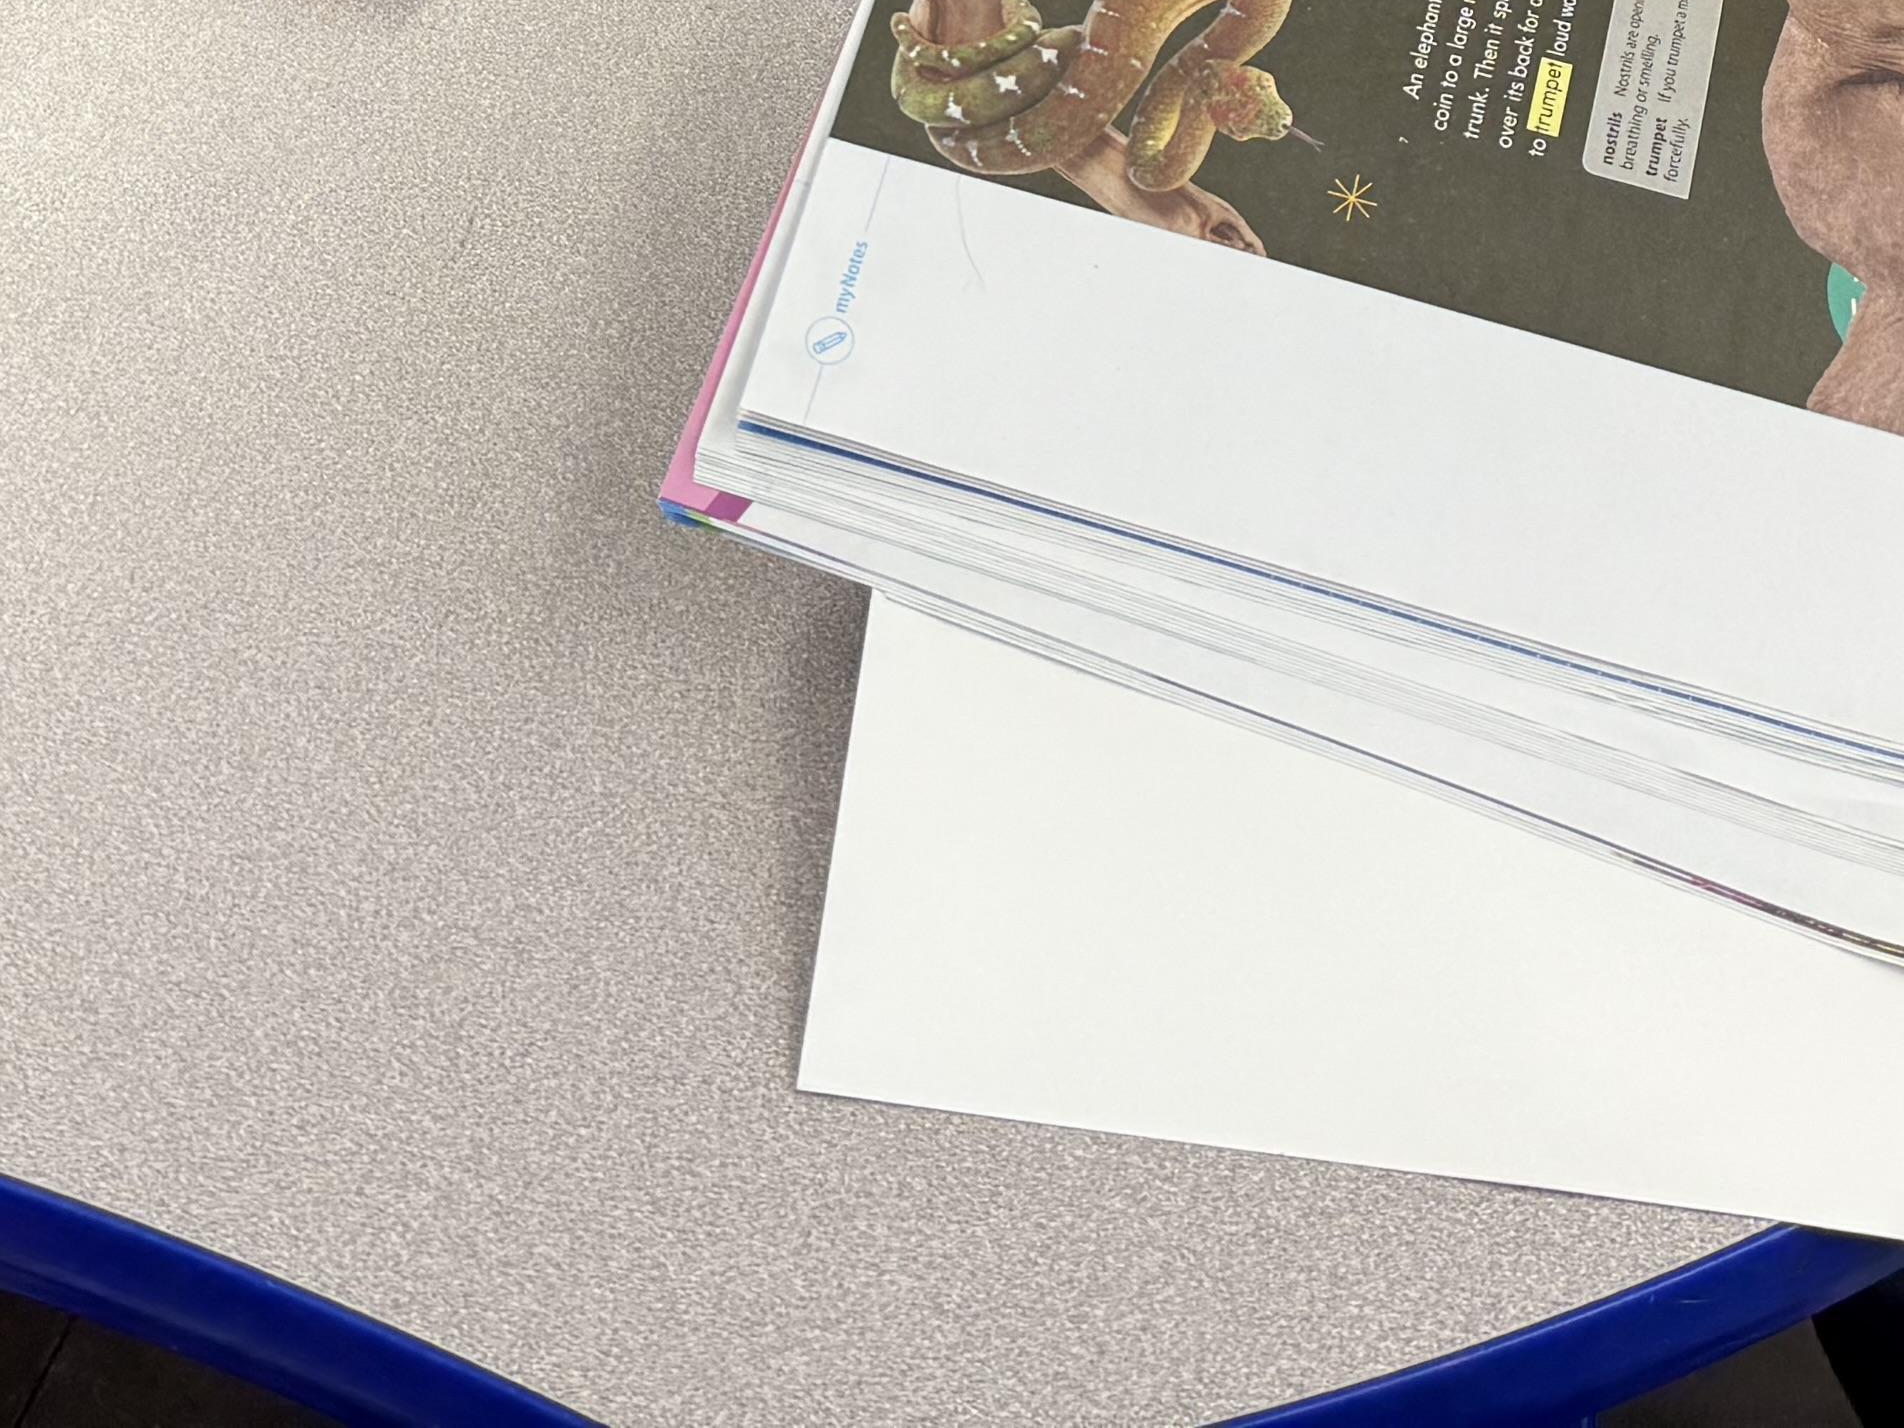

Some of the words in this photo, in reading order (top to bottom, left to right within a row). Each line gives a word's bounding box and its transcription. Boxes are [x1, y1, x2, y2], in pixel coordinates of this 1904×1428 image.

[1446, 6, 1476, 49] large
[1483, 22, 1504, 35] it
[1517, 9, 1539, 33] for
[1675, 10, 1688, 19] a
[1546, 18, 1572, 56] loud
[1666, 18, 1686, 66] trumpet
[1448, 53, 1463, 67] a
[1473, 38, 1500, 78] Then
[1507, 36, 1534, 78] back
[1638, 34, 1661, 86] smelling.
[1402, 72, 1424, 100] An
[1440, 69, 1459, 88] to
[1503, 80, 1525, 102] its
[1535, 57, 1564, 137] trumpet
[1603, 111, 1623, 165] nostrils
[1613, 50, 1635, 97] Nostrils
[1625, 29, 1640, 49] are
[1635, 86, 1648, 103] or
[1656, 90, 1672, 103] If
[1662, 67, 1677, 93] you
[1432, 92, 1454, 131] coin
[1463, 87, 1489, 138] trunk.
[1498, 106, 1518, 148] over
[1528, 137, 1547, 156] to
[1620, 104, 1648, 170] breathing
[1645, 117, 1668, 176] trumpet
[1663, 118, 1690, 182] forcefully.
[835, 241, 868, 313] myNotes
